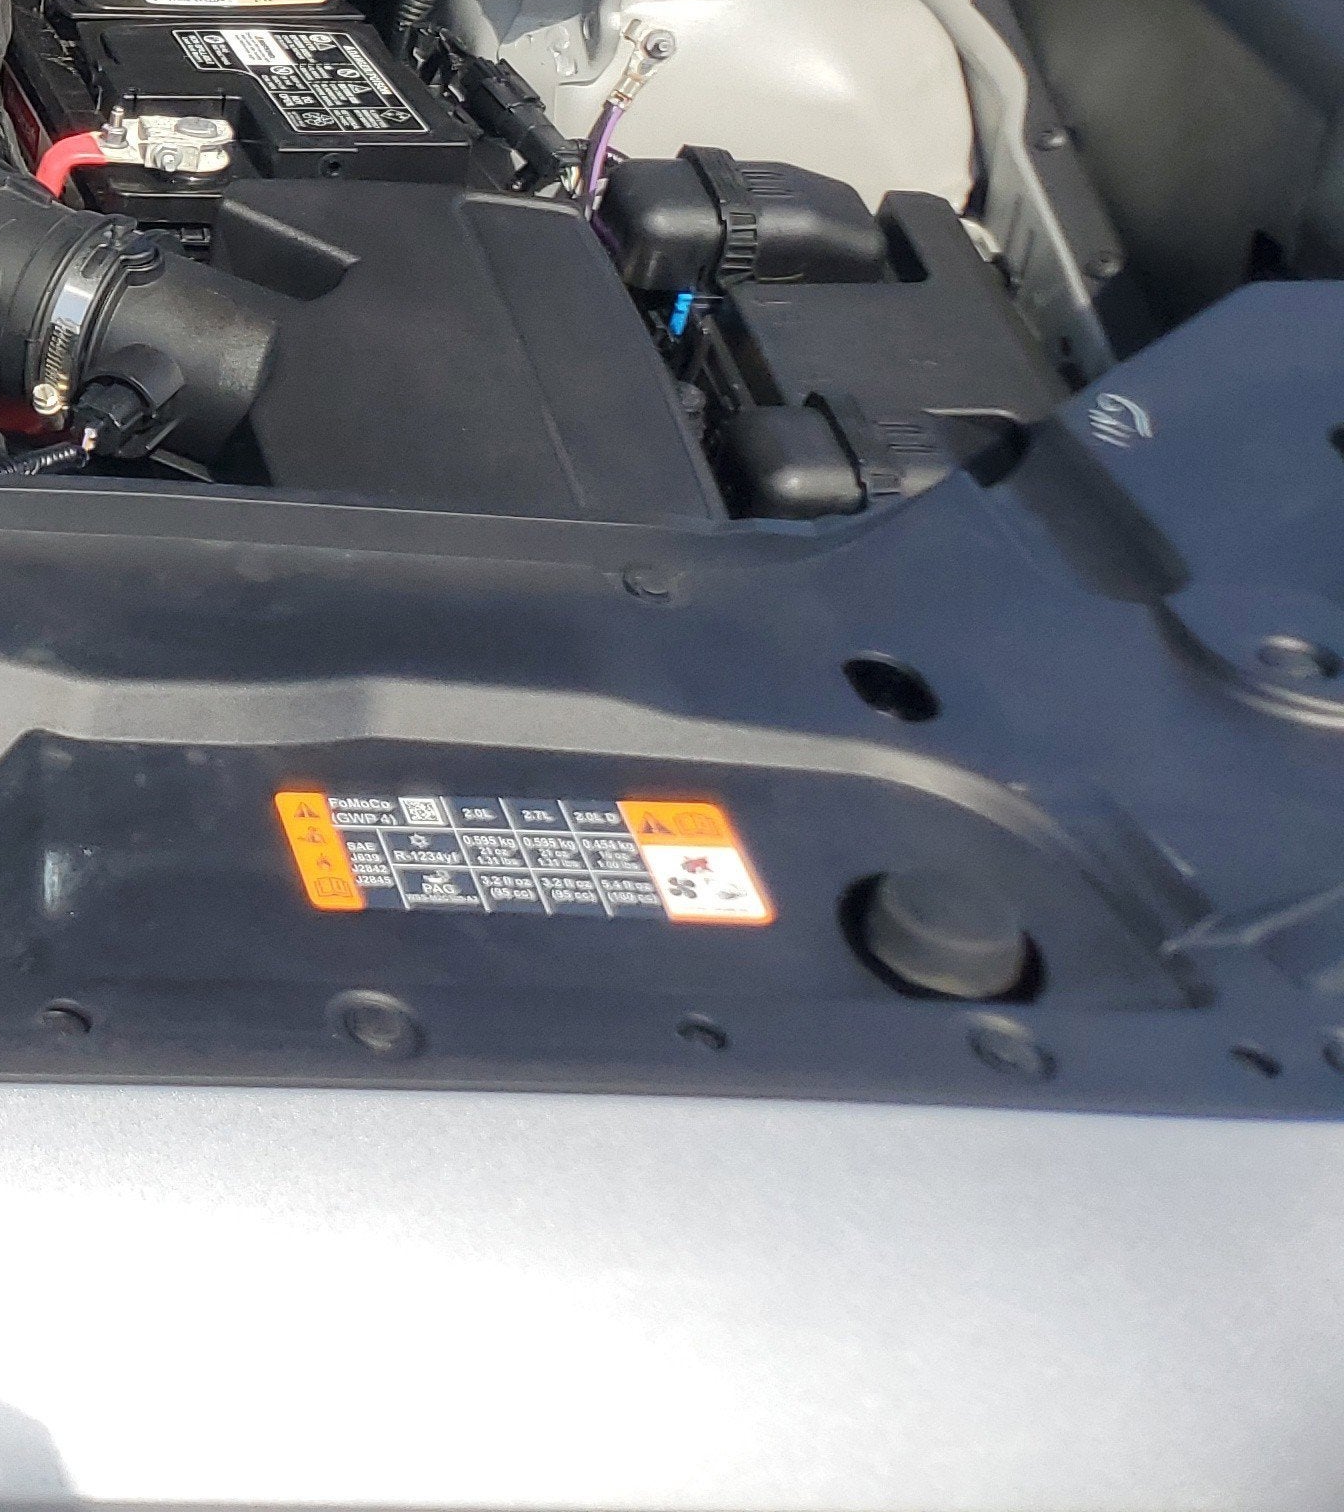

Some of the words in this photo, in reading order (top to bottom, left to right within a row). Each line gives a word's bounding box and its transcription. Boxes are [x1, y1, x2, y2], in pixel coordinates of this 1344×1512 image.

[328, 797, 391, 809] FoMoCo
[332, 813, 376, 825] (GWP
[380, 814, 398, 825] 4)
[462, 807, 493, 820] 2.0L
[522, 809, 553, 821] 2.7L
[574, 811, 604, 823] 2.0L
[346, 841, 376, 851] SAE
[463, 835, 496, 846] 0.595
[499, 836, 515, 848] kg
[523, 837, 556, 848] 0.595
[560, 838, 576, 850] kg
[620, 840, 635, 852] kg
[351, 853, 381, 862] J639
[393, 849, 460, 864] R-1234yf
[477, 856, 499, 865] 1.31
[352, 864, 389, 874] J2842
[356, 875, 392, 885] J2845
[481, 875, 500, 885] 3.2
[541, 877, 560, 887] 3.2
[421, 883, 456, 894] PAG
[490, 888, 508, 899] (95
[514, 889, 536, 900] cc)
[551, 890, 570, 900] (95
